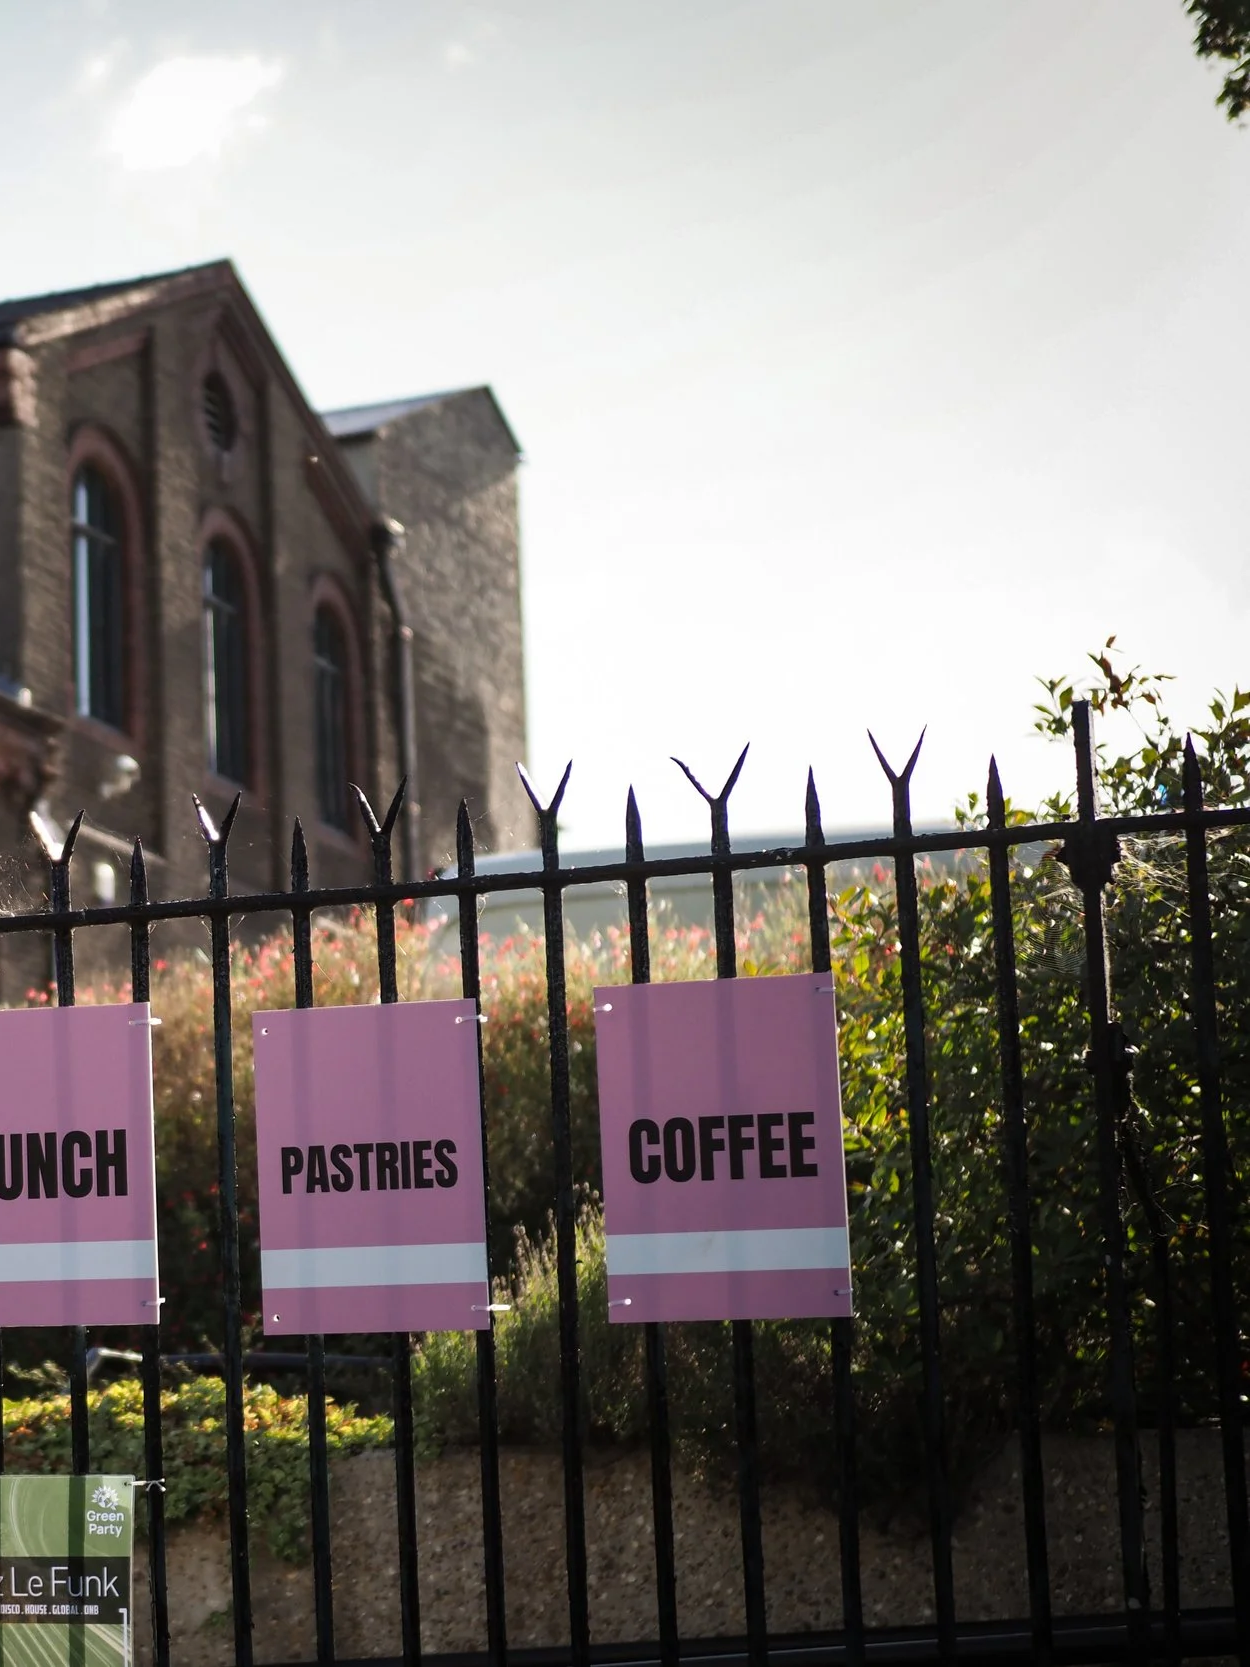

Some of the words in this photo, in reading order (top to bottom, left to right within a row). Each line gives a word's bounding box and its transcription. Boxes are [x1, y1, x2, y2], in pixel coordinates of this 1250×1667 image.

[629, 1111, 818, 1184] COFFEE
[281, 1139, 458, 1194] PASTRIES
[86, 1510, 124, 1521] Green
[88, 1523, 122, 1538] Party
[11, 1566, 43, 1597] Le
[51, 1566, 120, 1597] Funk
